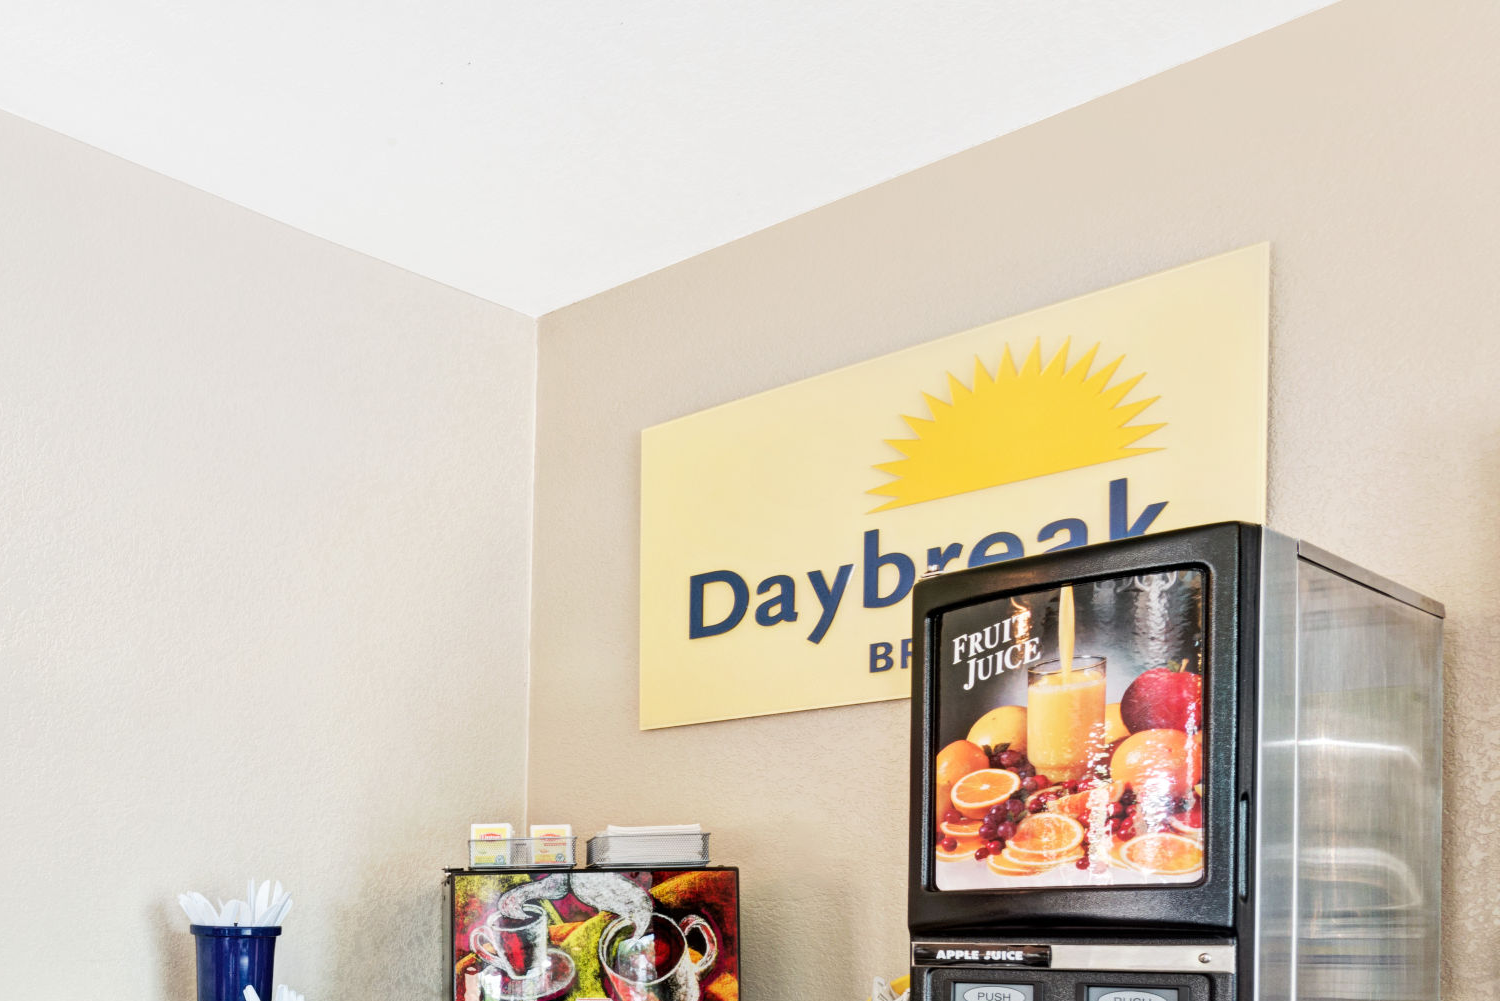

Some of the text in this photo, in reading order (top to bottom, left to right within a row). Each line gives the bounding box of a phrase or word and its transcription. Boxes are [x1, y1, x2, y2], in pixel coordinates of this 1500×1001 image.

[952, 611, 1031, 665] FRUIT
[963, 637, 1041, 690] JUICE
[936, 949, 1024, 960] APPLE JUICE
[977, 992, 1011, 1001] PUSH
